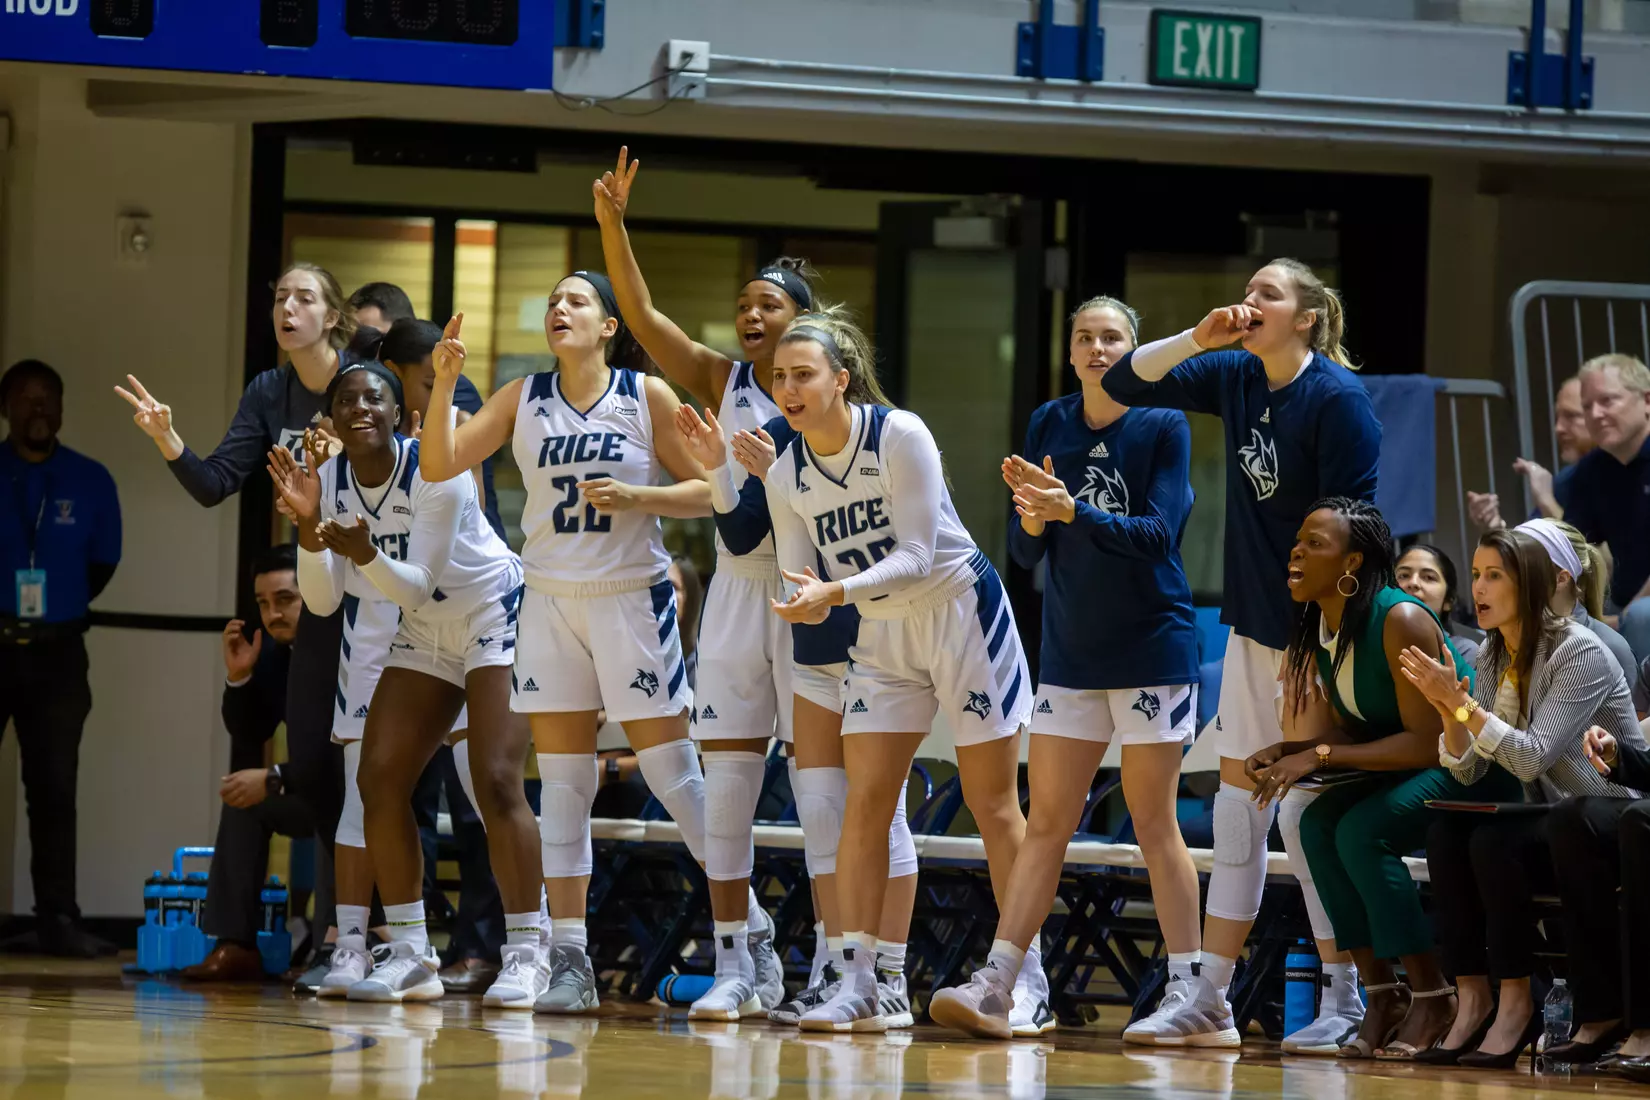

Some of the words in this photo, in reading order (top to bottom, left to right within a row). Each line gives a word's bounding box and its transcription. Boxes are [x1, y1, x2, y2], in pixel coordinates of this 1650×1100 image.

[1172, 21, 1245, 79] EXIT
[538, 432, 628, 468] RICE
[813, 497, 890, 547] RICE
